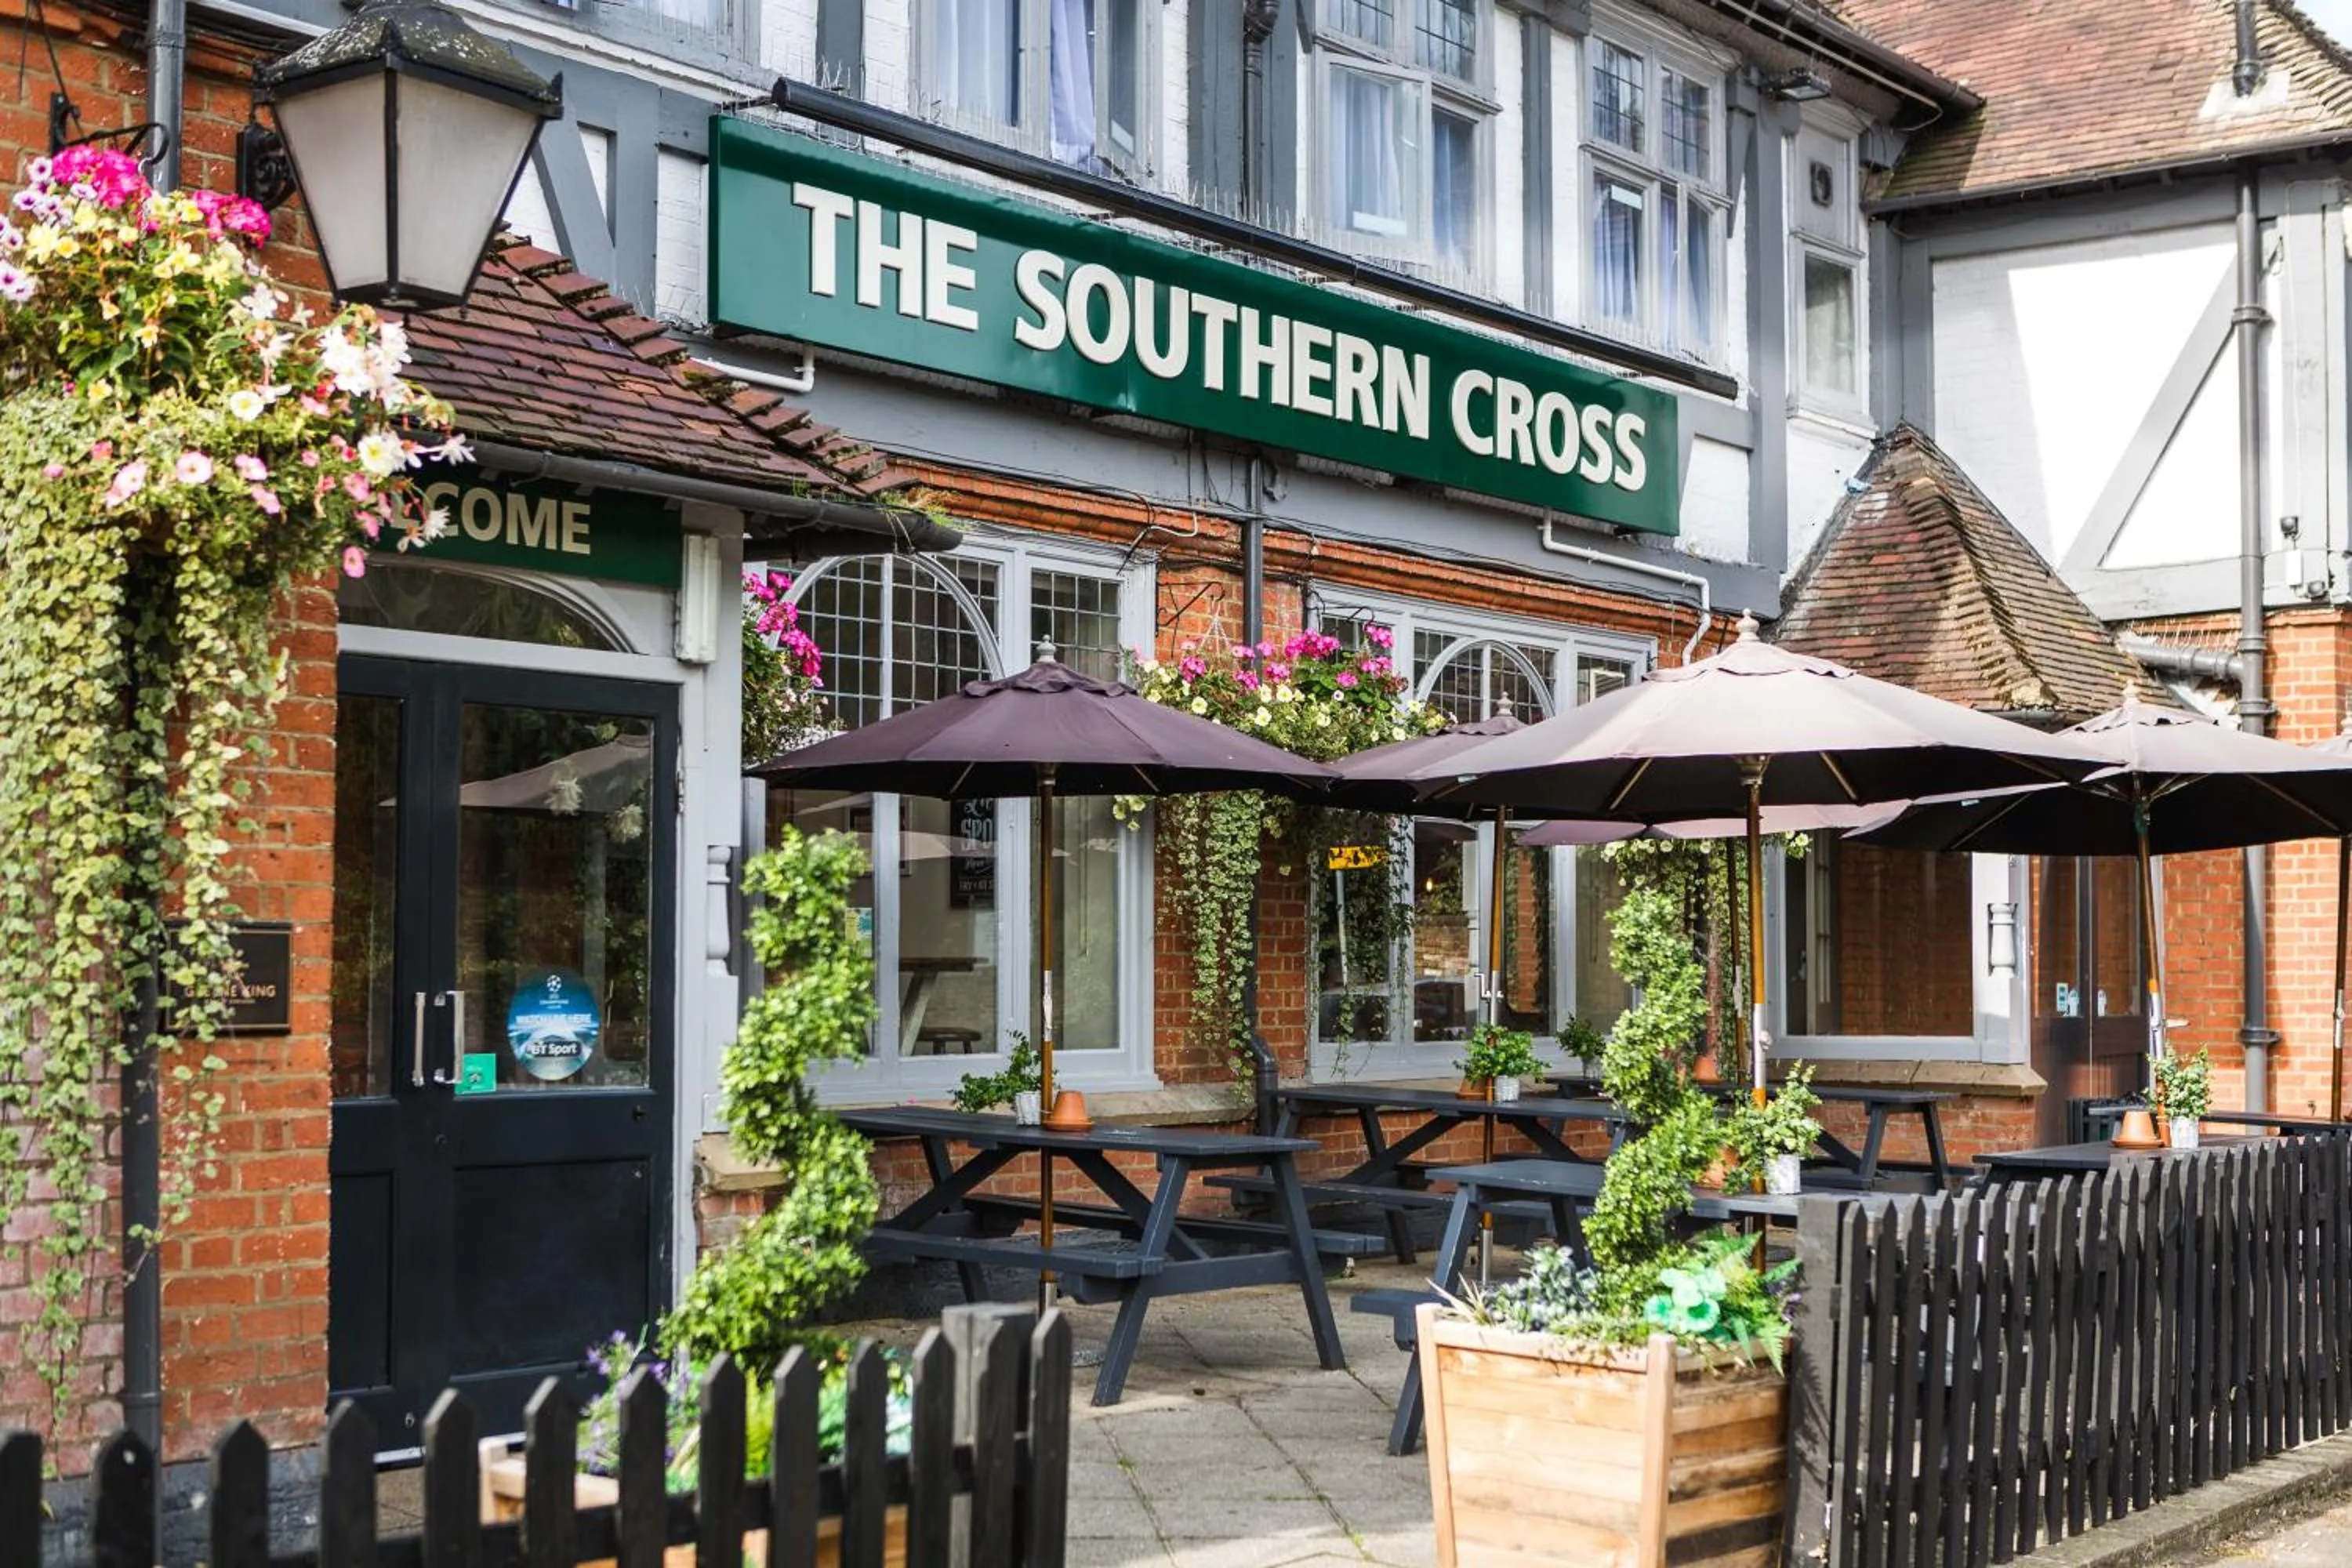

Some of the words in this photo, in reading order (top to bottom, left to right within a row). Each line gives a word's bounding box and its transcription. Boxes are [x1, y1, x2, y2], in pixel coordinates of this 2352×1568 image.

[791, 182, 980, 331] THE
[1014, 250, 1430, 441] SOUTHERN
[1450, 369, 1648, 492] CROSS
[379, 482, 590, 554] LCOME
[960, 818, 993, 851] SPO
[548, 1043, 578, 1057] Sport
